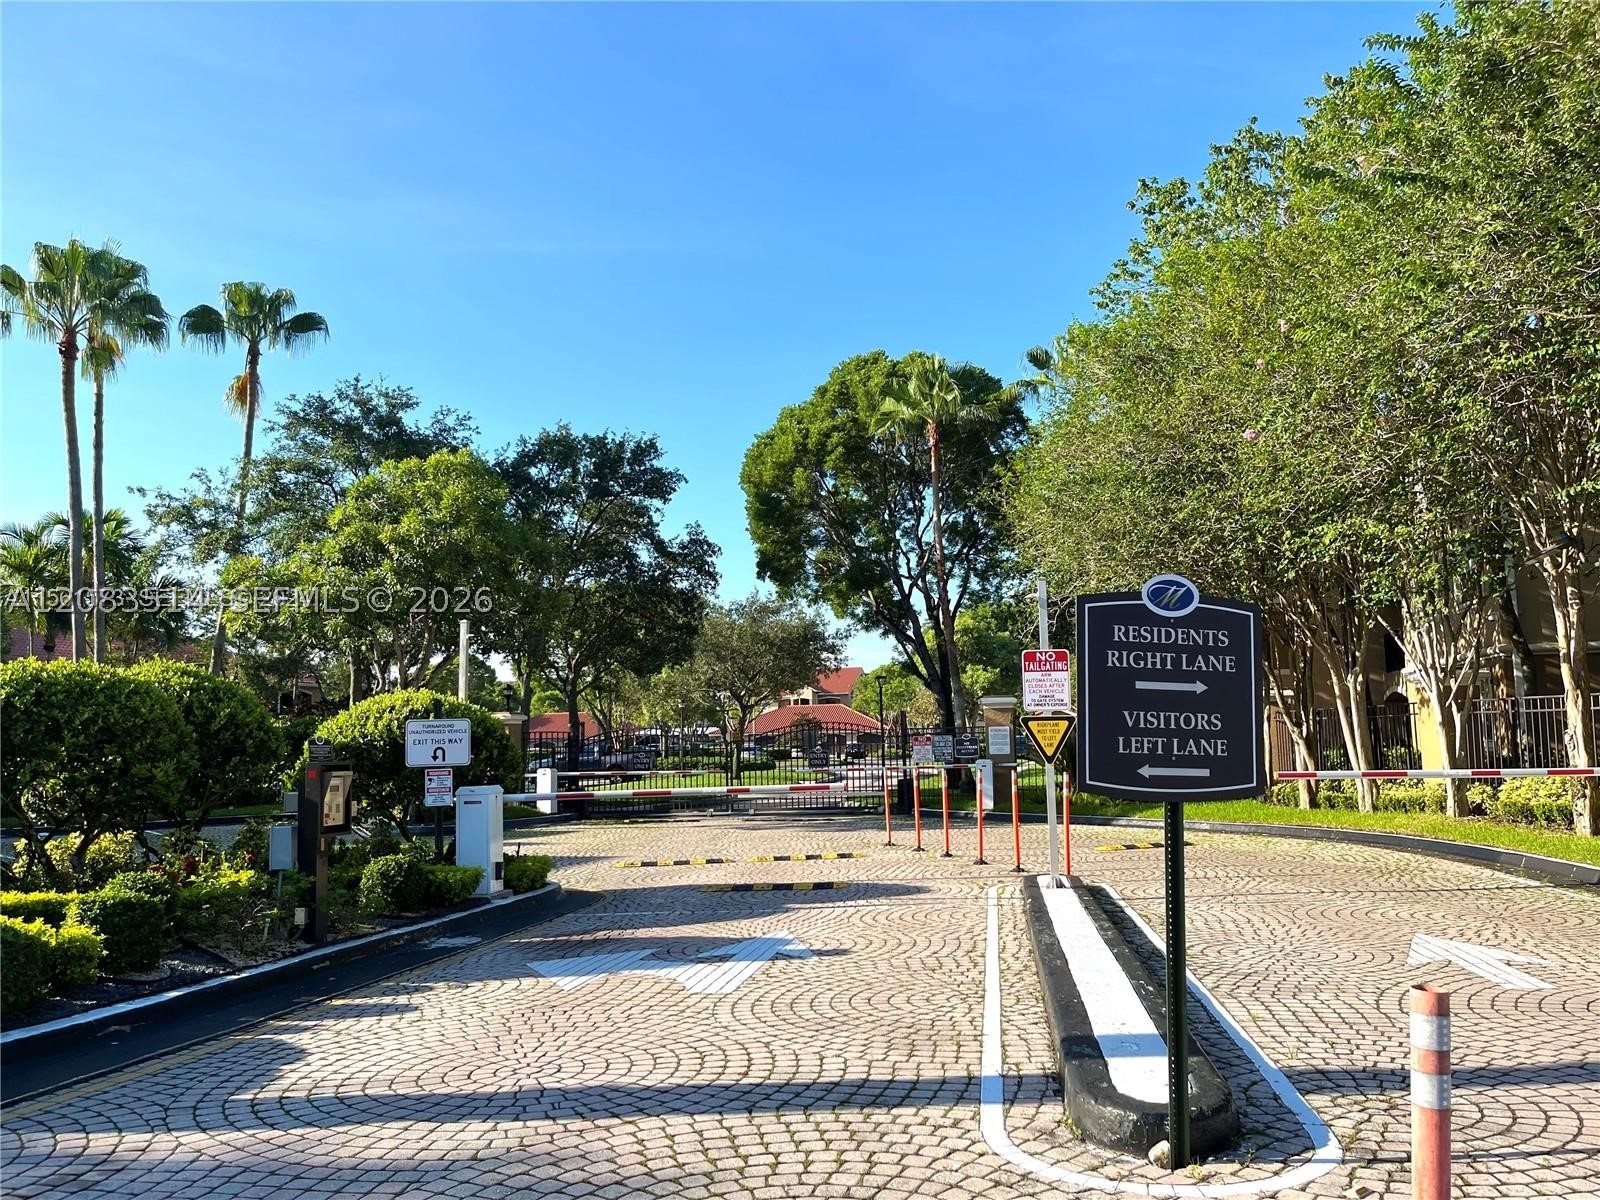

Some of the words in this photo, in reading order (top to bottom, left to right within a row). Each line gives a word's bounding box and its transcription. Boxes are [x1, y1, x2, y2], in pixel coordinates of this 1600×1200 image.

[1112, 625, 1229, 647] RESIDENTS
[1025, 661, 1068, 671] TAILGATING
[1036, 651, 1056, 661] NO
[1107, 650, 1175, 670] RIGHT
[1181, 653, 1236, 672] LANE
[1122, 710, 1222, 731] VISITORS
[1117, 737, 1166, 755] LEFT
[1172, 738, 1228, 756] LANE
